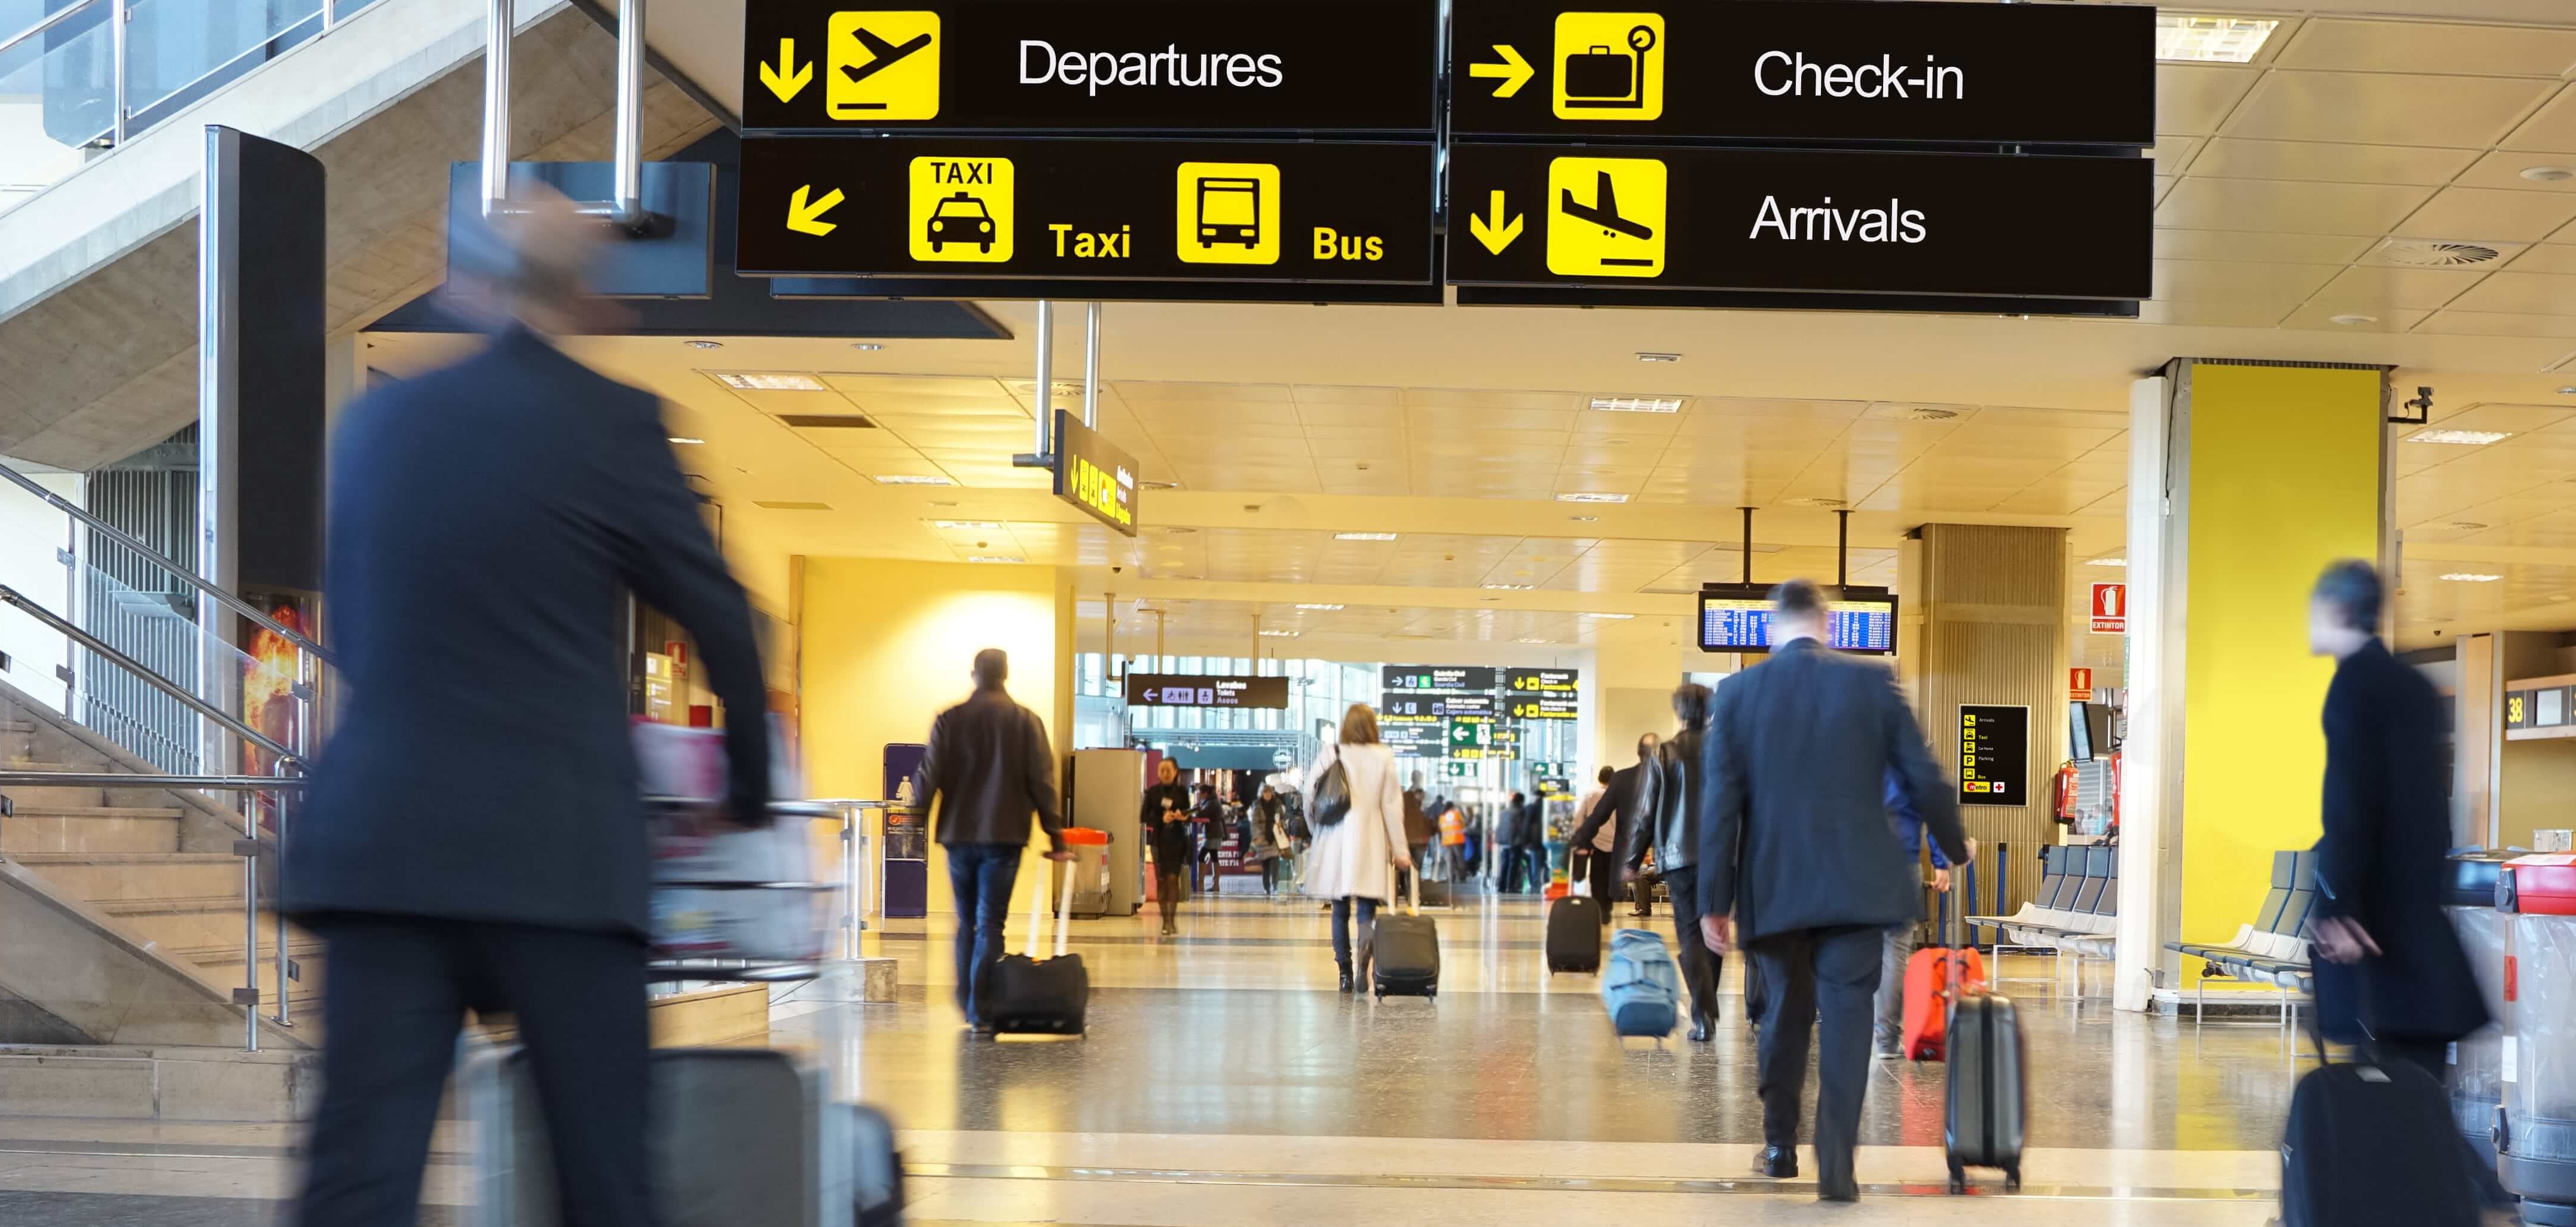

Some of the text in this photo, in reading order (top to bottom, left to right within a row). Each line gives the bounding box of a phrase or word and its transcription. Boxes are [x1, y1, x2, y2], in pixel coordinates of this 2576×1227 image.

[1020, 40, 1283, 96] Departures
[1754, 51, 1963, 99] Check-in
[931, 162, 992, 184] TAXI
[1749, 196, 1926, 243] Arrivals
[1049, 224, 1130, 258] Taxi
[1313, 227, 1383, 261] Bus
[2092, 621, 2125, 630] EXTINTOR
[2508, 697, 2523, 722] 38
